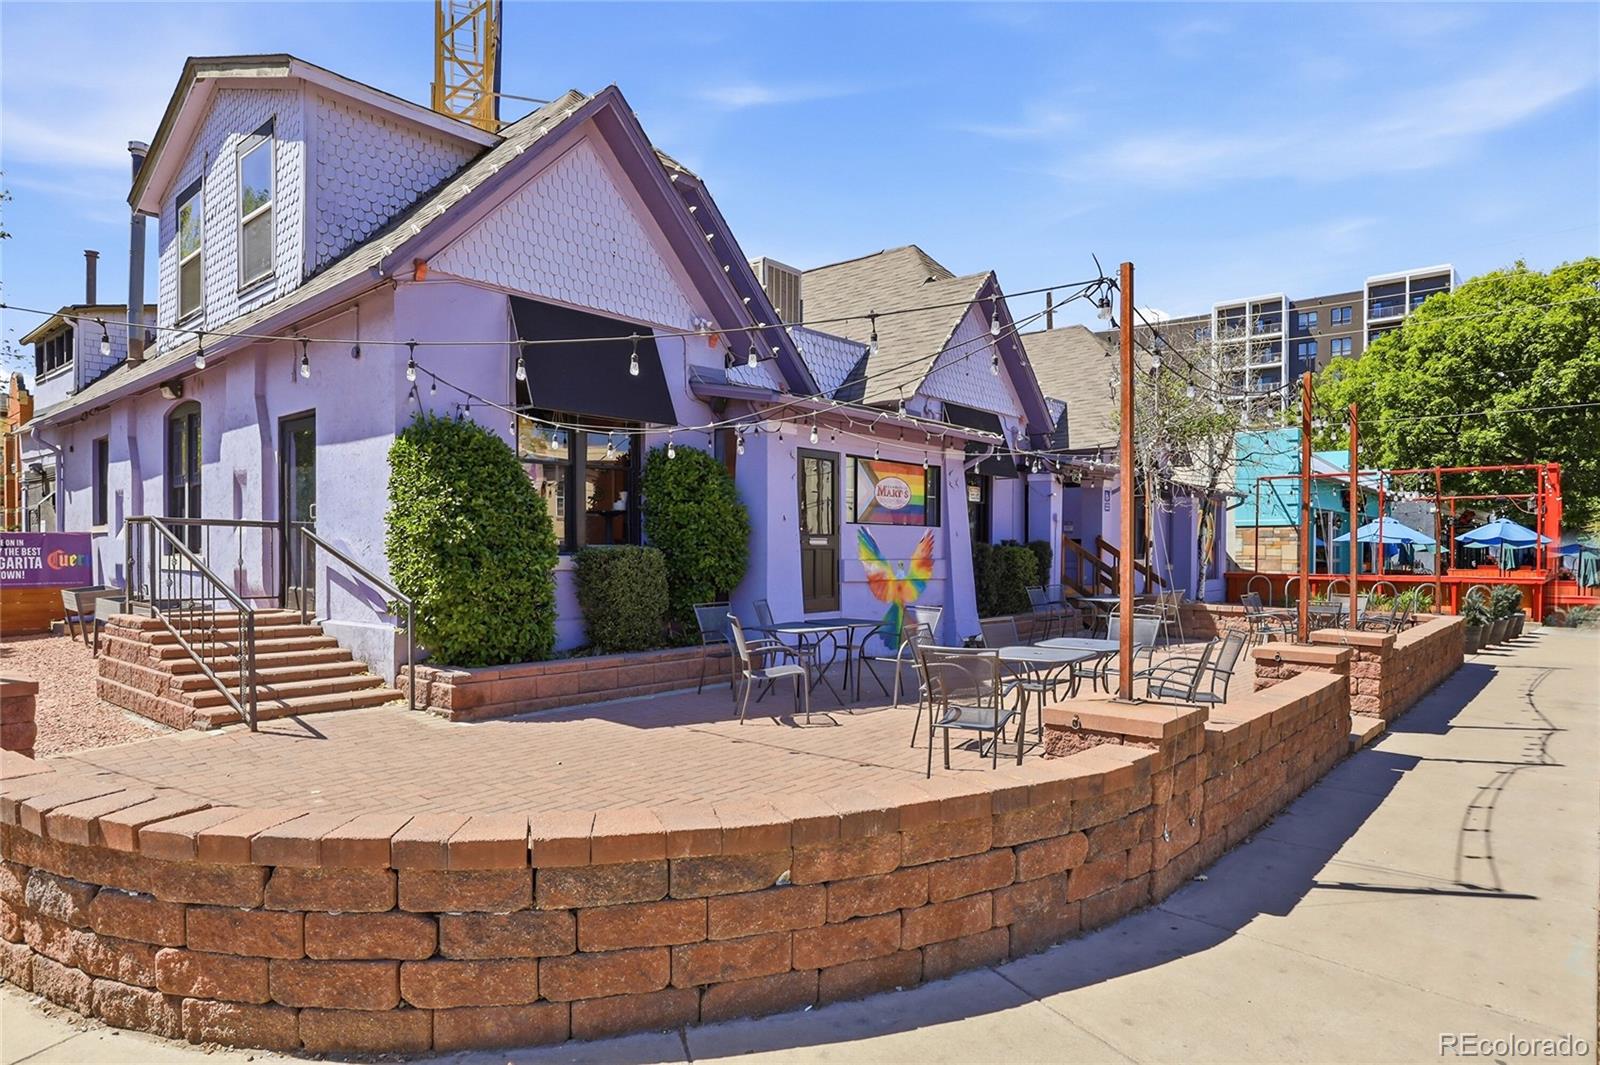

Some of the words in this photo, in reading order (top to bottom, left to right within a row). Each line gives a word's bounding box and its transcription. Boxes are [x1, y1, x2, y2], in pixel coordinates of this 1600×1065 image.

[4, 547, 20, 556] THE
[21, 547, 41, 556] BEST
[0, 556, 43, 569] GARITA
